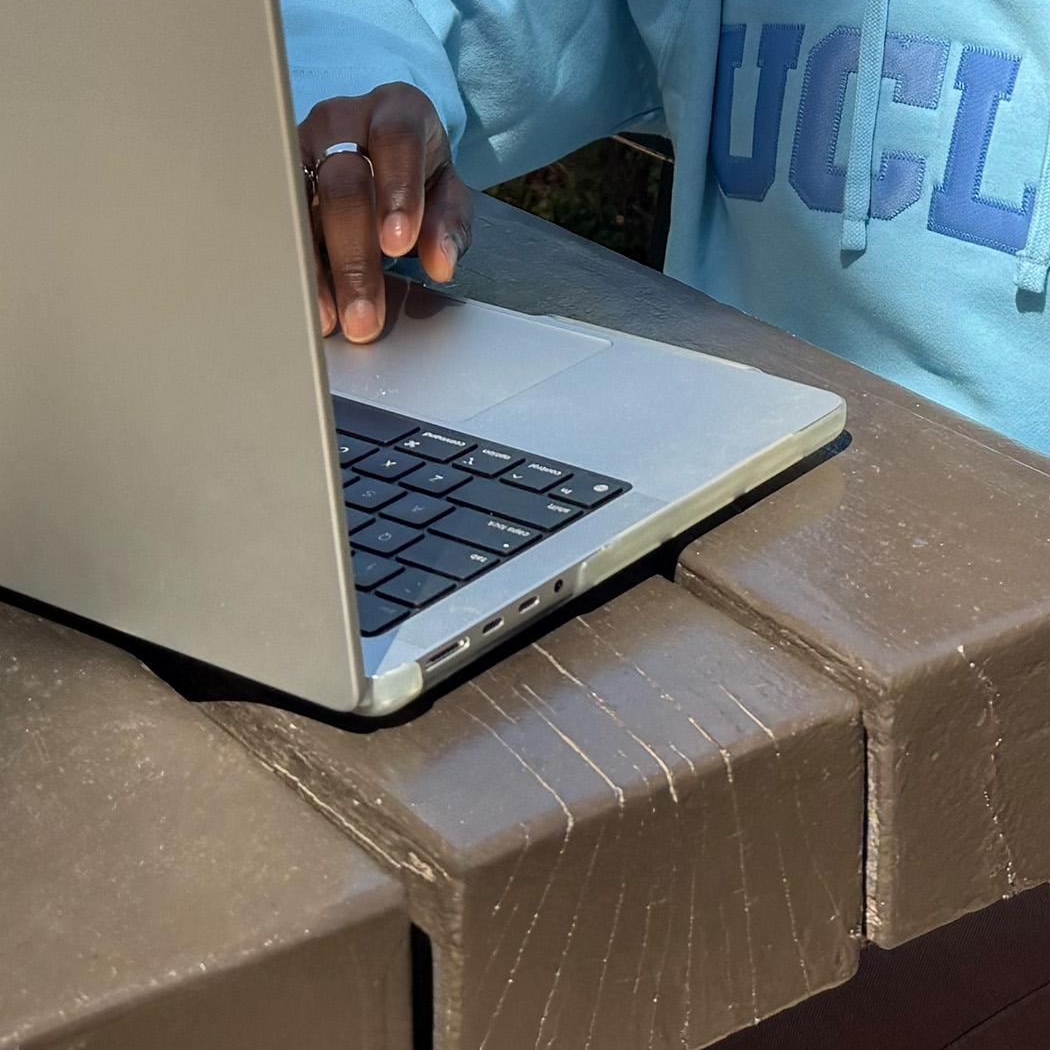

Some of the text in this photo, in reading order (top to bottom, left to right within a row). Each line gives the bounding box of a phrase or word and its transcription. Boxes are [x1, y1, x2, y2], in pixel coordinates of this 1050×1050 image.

[422, 432, 466, 446] command
[482, 449, 511, 460] option
[528, 463, 562, 475] control
[546, 503, 572, 514] shift
[487, 520, 531, 537] caps lock
[470, 553, 488, 563] tab
